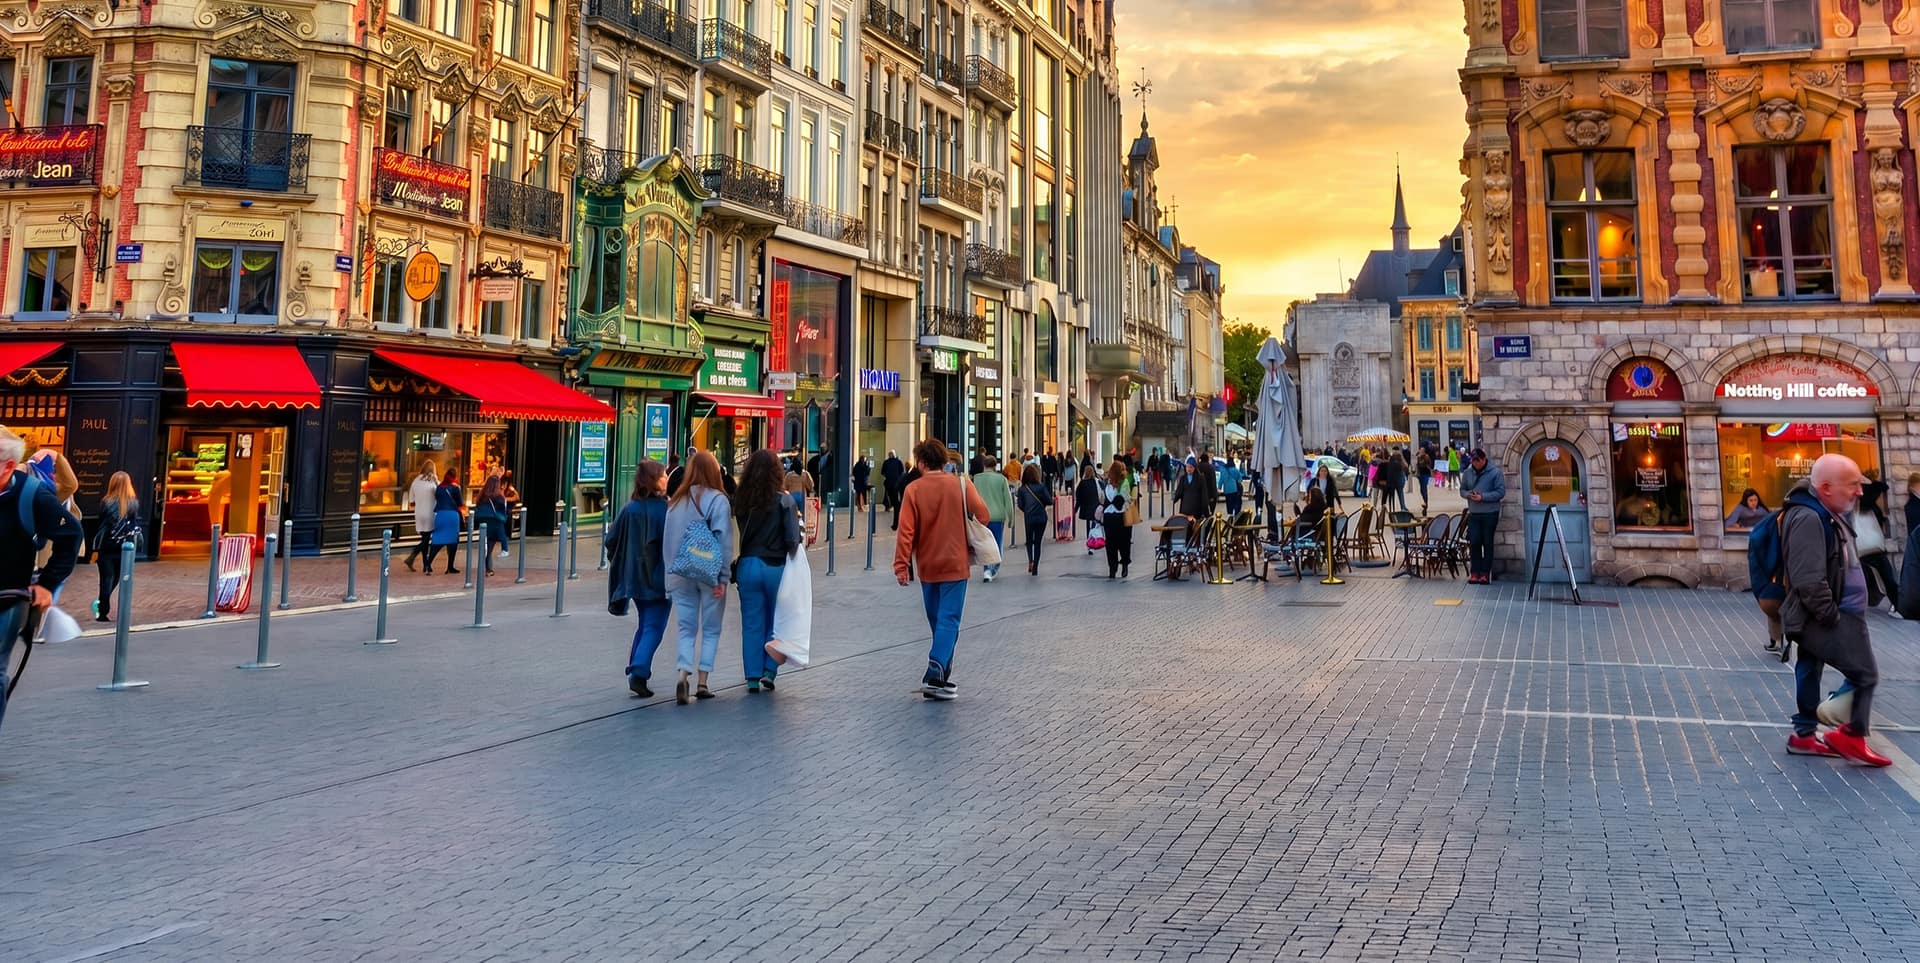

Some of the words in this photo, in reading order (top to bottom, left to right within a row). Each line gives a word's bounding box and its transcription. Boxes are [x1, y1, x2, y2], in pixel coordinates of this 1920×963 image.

[33, 160, 72, 179] Jean
[440, 192, 464, 212] Jean
[1724, 383, 1783, 400] Notting
[1787, 382, 1815, 398] Hill
[1817, 382, 1867, 398] coffee
[81, 418, 109, 430] PAUL
